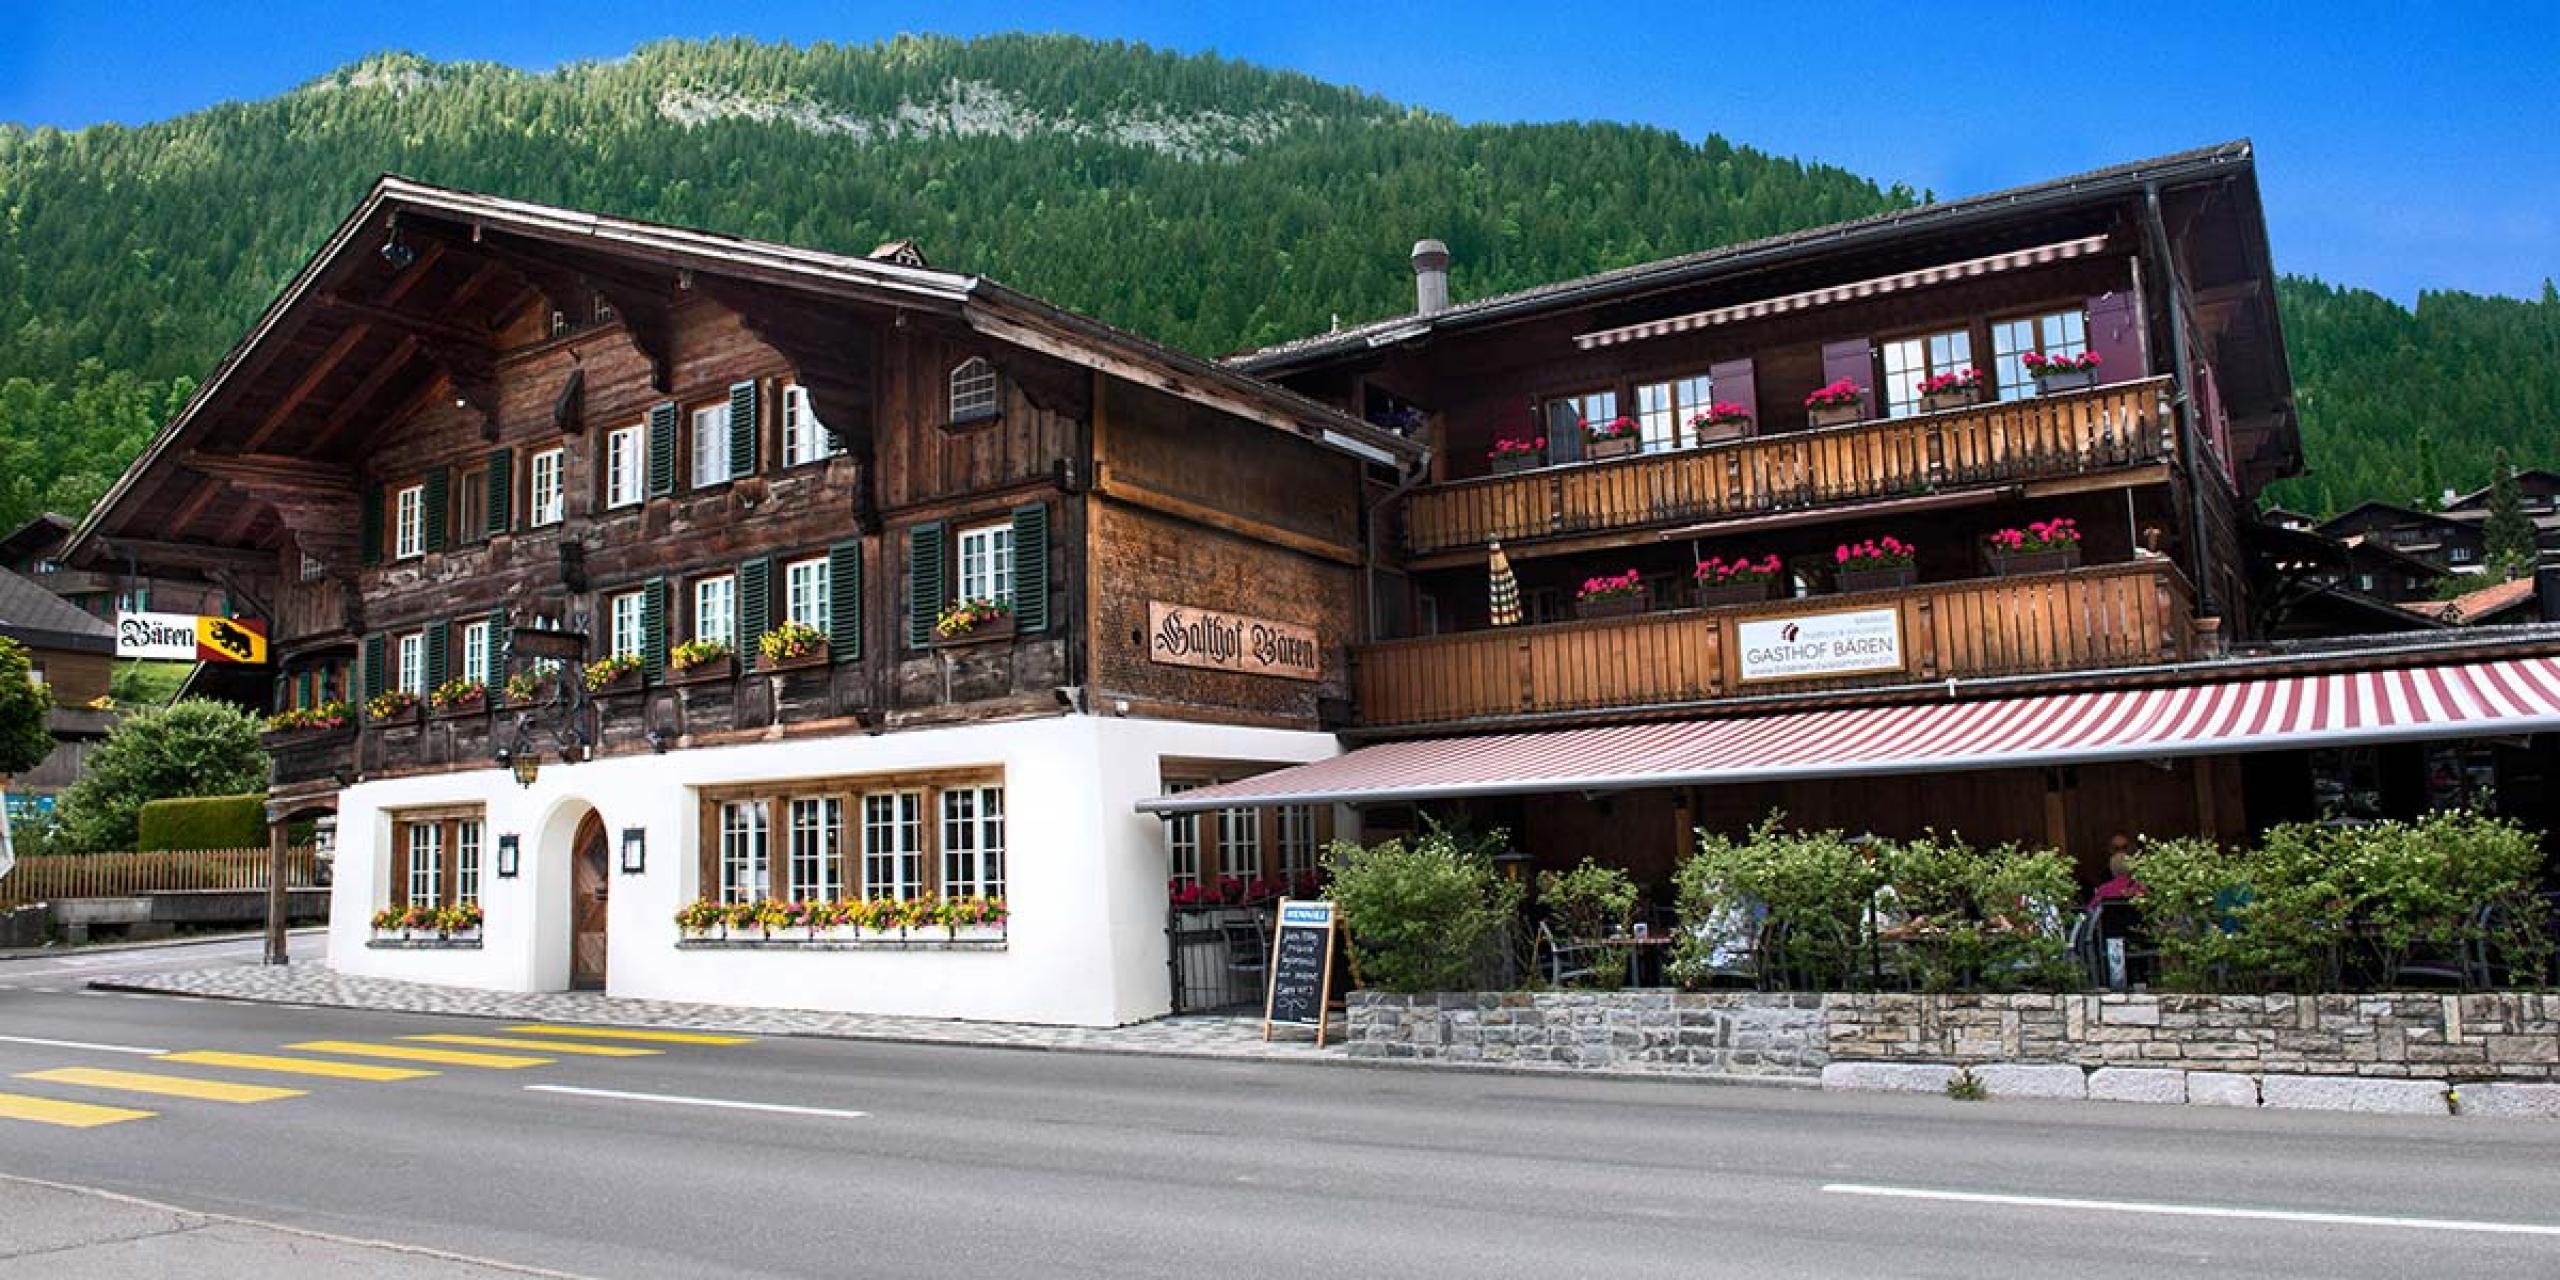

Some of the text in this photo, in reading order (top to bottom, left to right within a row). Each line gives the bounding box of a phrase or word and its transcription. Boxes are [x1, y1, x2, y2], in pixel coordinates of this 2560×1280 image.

[121, 618, 195, 647] Bären
[1154, 609, 1315, 669] Gasthof Bären
[1746, 642, 1828, 664] GASTHOF
